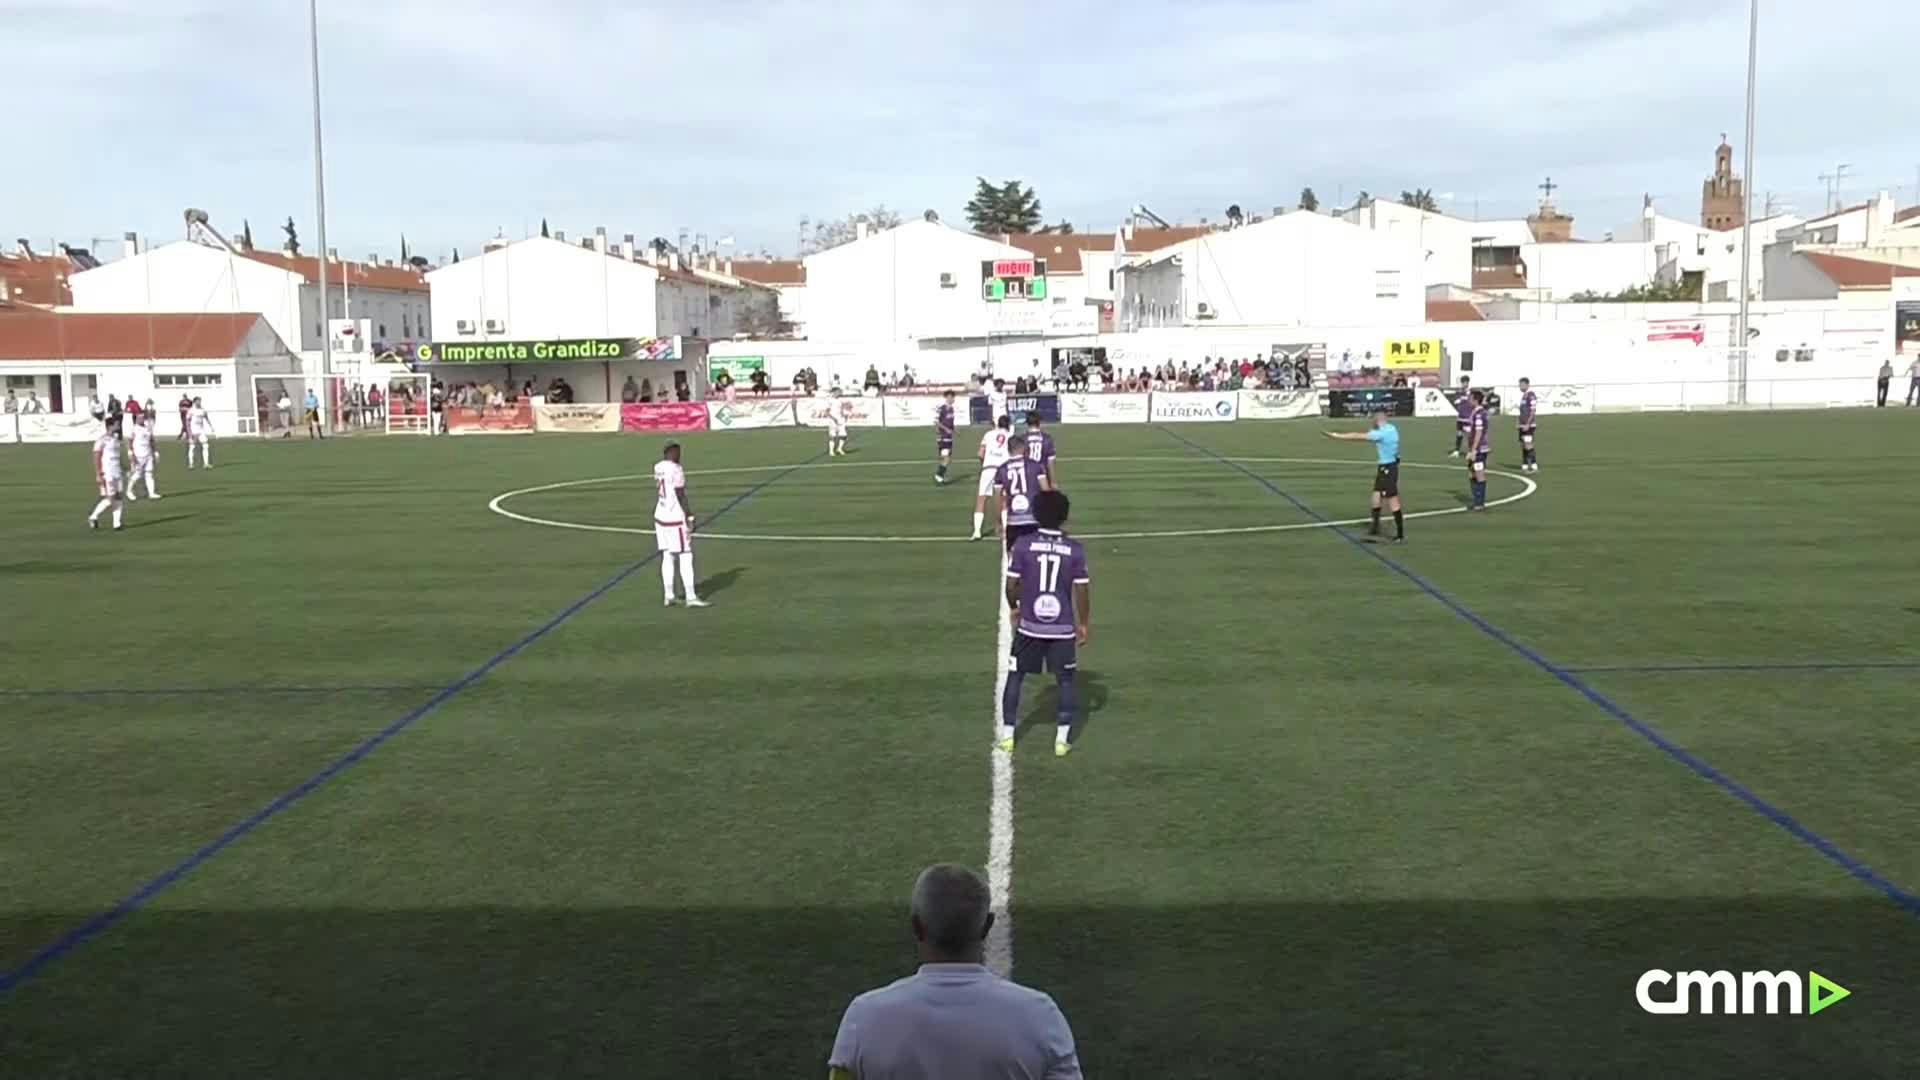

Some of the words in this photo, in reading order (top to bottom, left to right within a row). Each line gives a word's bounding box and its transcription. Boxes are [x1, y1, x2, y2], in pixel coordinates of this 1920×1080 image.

[417, 344, 433, 361] G
[441, 343, 528, 362] Imprenta
[533, 340, 621, 359] Grandizo
[996, 434, 1006, 449] 9
[1028, 442, 1043, 462] 18
[1007, 468, 1028, 493] 21
[1037, 553, 1061, 592] 17
